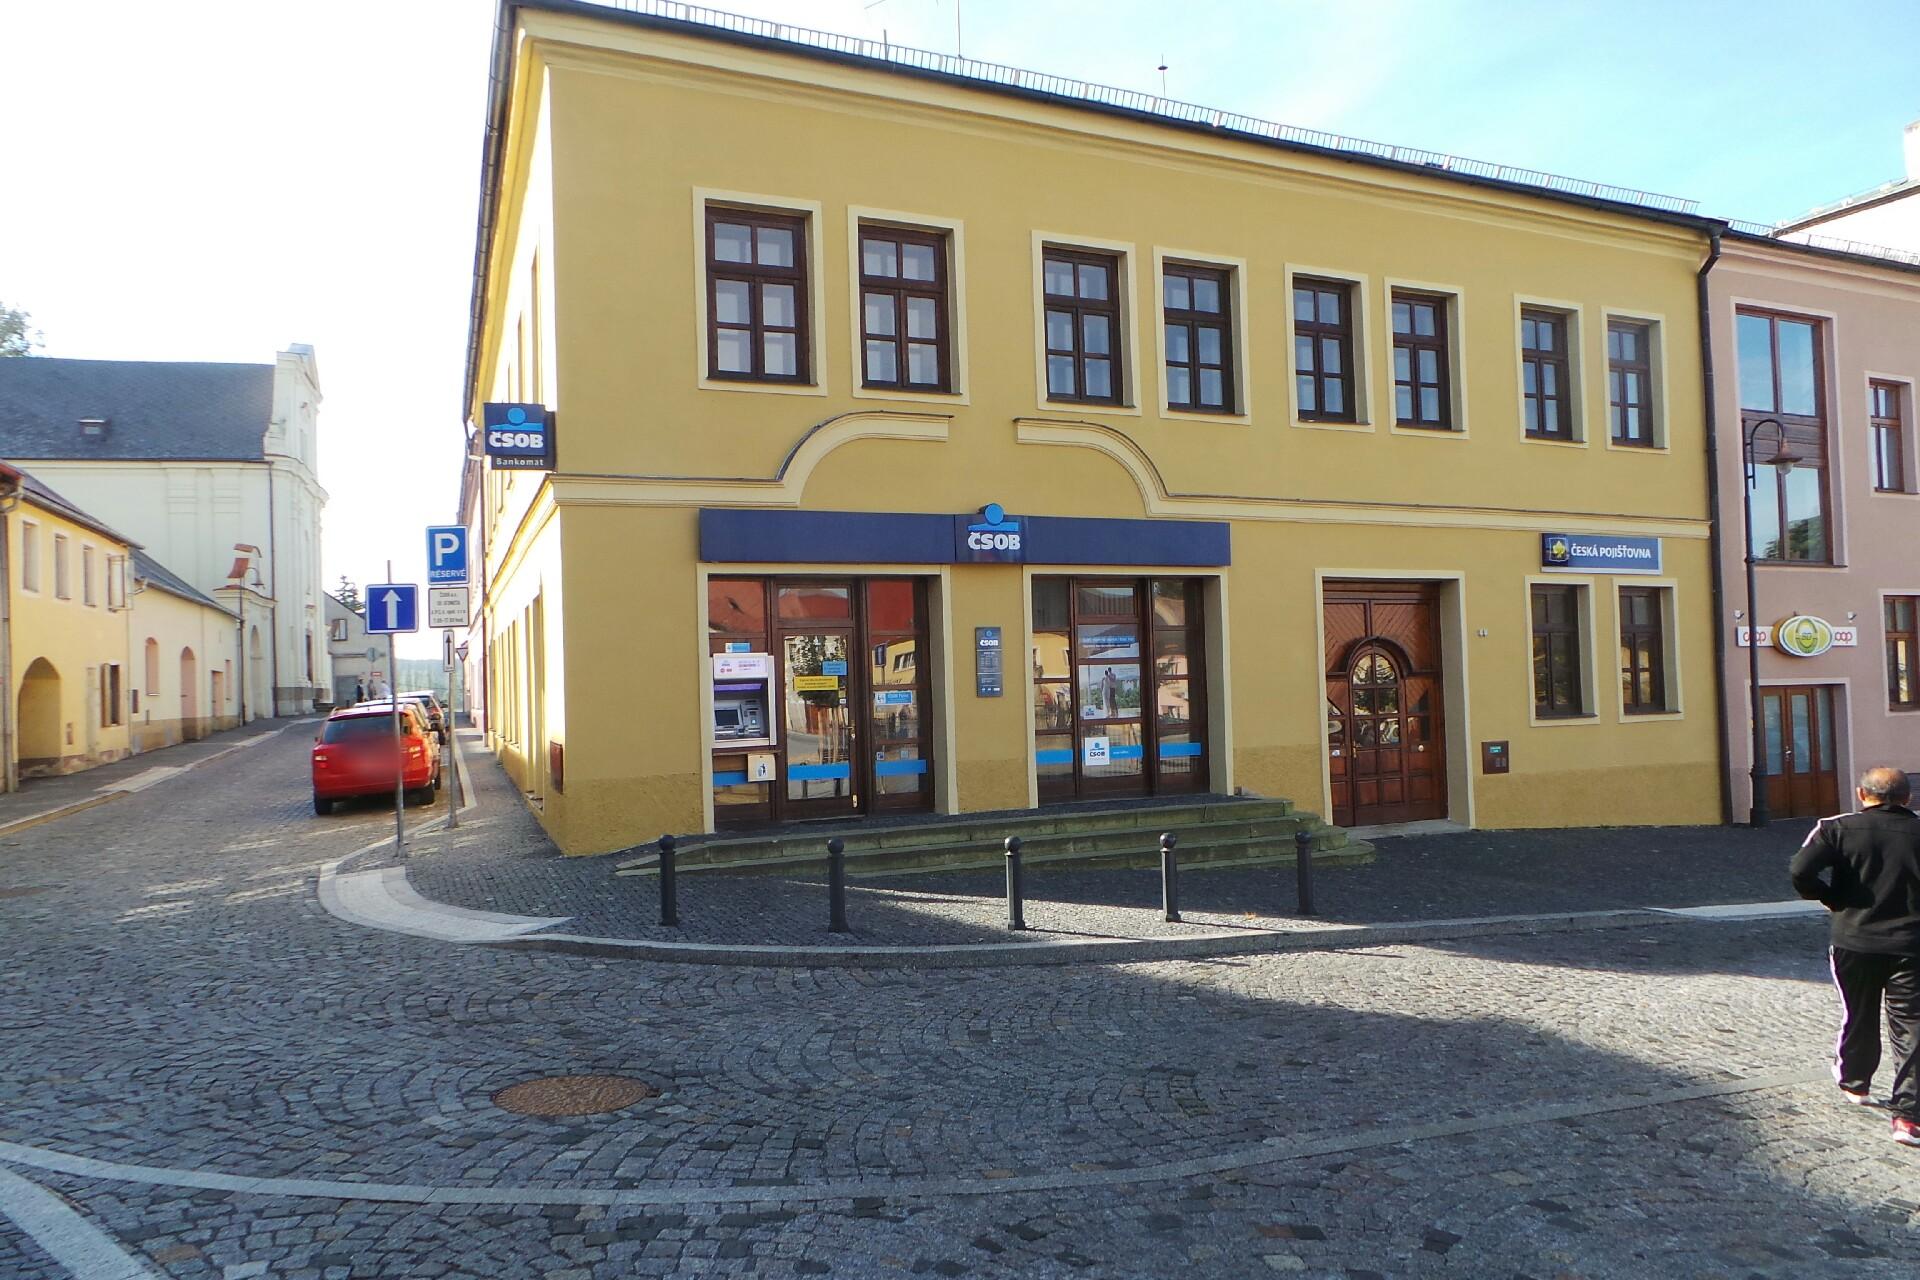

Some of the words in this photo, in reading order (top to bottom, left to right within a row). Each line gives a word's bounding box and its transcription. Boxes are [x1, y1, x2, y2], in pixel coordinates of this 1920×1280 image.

[489, 431, 544, 448] ČSOB
[496, 457, 544, 466] Bankomat
[967, 531, 1021, 550] ČSOB
[434, 533, 460, 566] P
[1570, 543, 1599, 557] ČESKÁ
[1599, 544, 1652, 559] POJIŠŤOVNA
